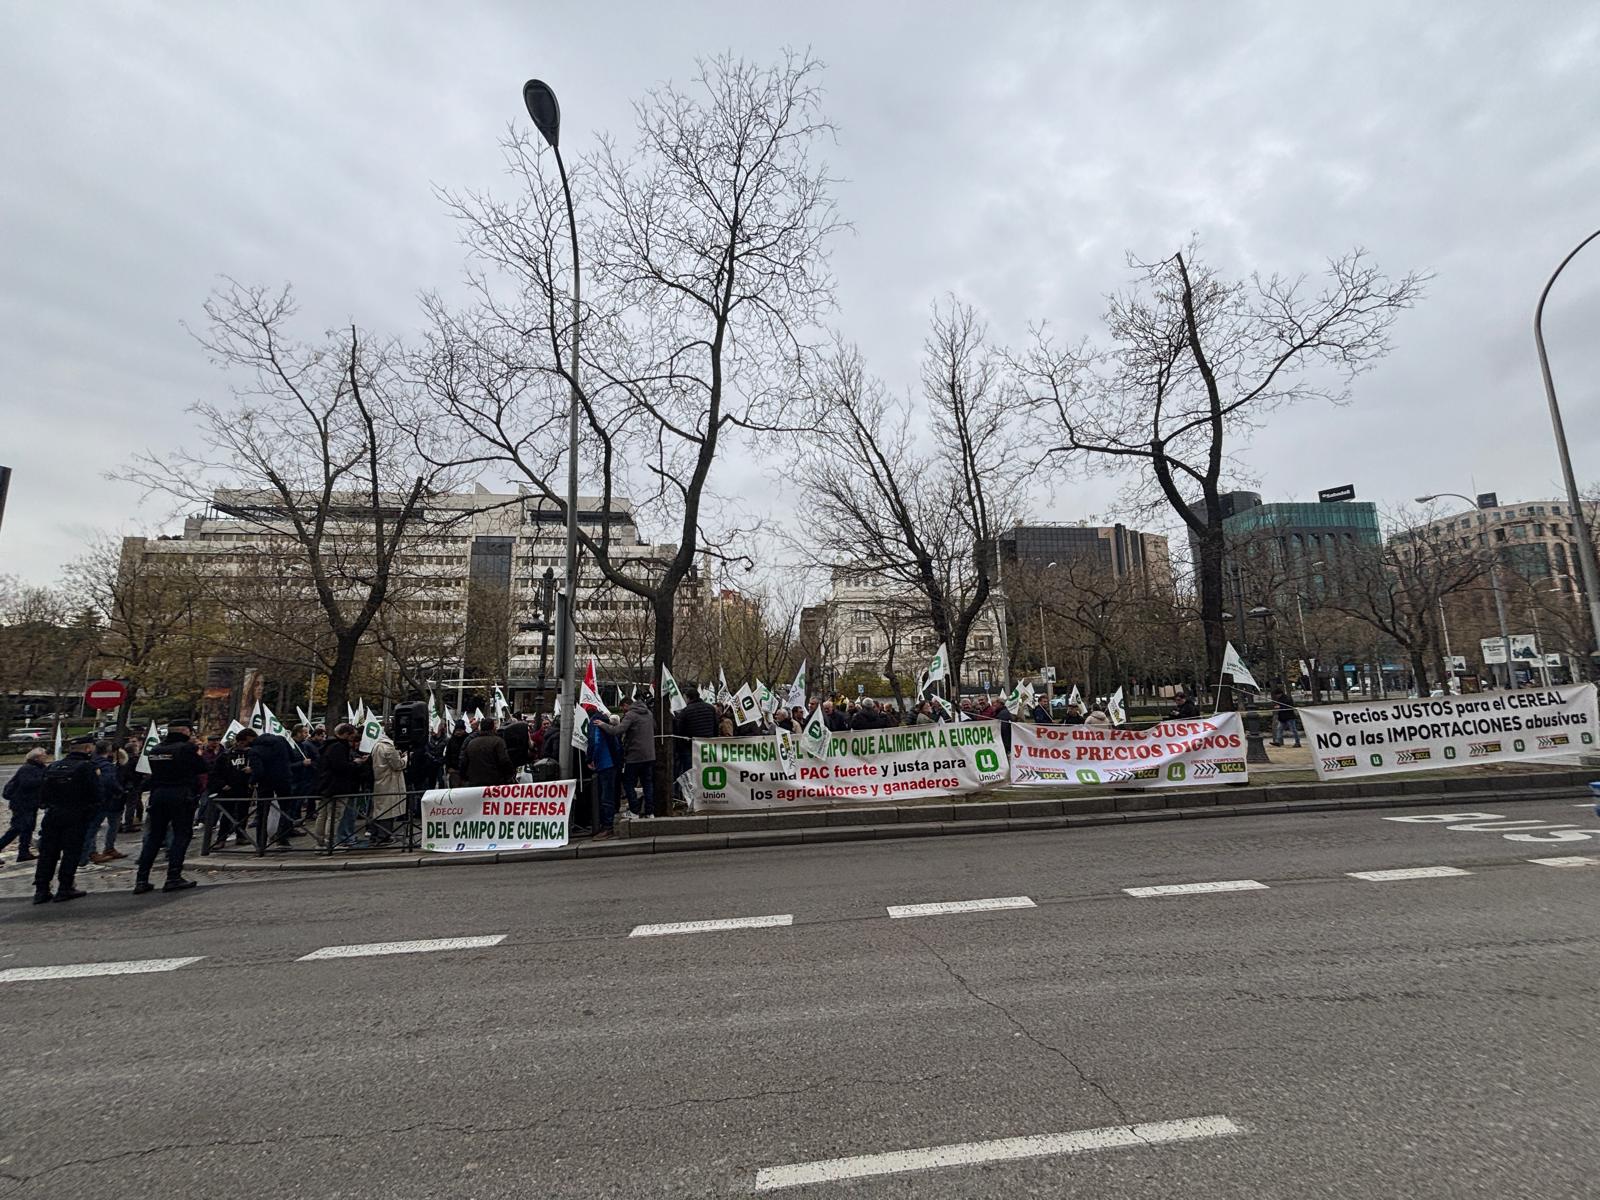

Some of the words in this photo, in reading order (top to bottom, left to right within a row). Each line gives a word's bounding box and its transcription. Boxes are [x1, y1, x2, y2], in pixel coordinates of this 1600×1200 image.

[1332, 708, 1389, 725] Precios
[1391, 701, 1453, 720] JUSTOS
[1455, 700, 1490, 717] para
[1492, 696, 1506, 711] el
[1507, 691, 1567, 709] CEREAL
[1036, 727, 1069, 740] Por
[1072, 730, 1105, 741] una
[1152, 722, 1218, 738] JUSTA
[1316, 732, 1342, 749] NO
[1345, 735, 1356, 747] a
[1360, 730, 1384, 745] las
[1387, 716, 1522, 743] IMPORTACIONES
[1525, 712, 1587, 729] abusivas
[701, 743, 717, 763] EN
[721, 741, 777, 763] DEFENSA
[851, 736, 875, 756] QUE
[878, 730, 936, 754] ALIMENTA
[938, 729, 947, 748] A
[950, 726, 995, 746] EUROPA
[1014, 745, 1023, 758] y
[1027, 746, 1071, 760] unos
[1076, 744, 1164, 761] PRECIOS
[1166, 734, 1242, 754] DIGNOS
[740, 770, 765, 782] Por
[770, 771, 797, 781] una
[800, 766, 830, 780] PAC
[834, 763, 877, 778] fuerte
[881, 764, 889, 777] y
[893, 760, 929, 776] justa
[933, 758, 966, 773] para
[482, 784, 568, 799] ASOCIACION
[750, 788, 773, 800] los
[777, 783, 867, 801] agricultores
[870, 784, 879, 796] y
[883, 777, 959, 795] ganaderos
[429, 807, 464, 816] ADECCU
[482, 802, 500, 815] EN
[503, 801, 566, 816] DEFENSA
[426, 821, 450, 839] DEL
[453, 820, 496, 839] CAMPO
[498, 821, 514, 840] DE
[517, 821, 565, 840] CUENCA
[1381, 812, 1600, 842] BUS
